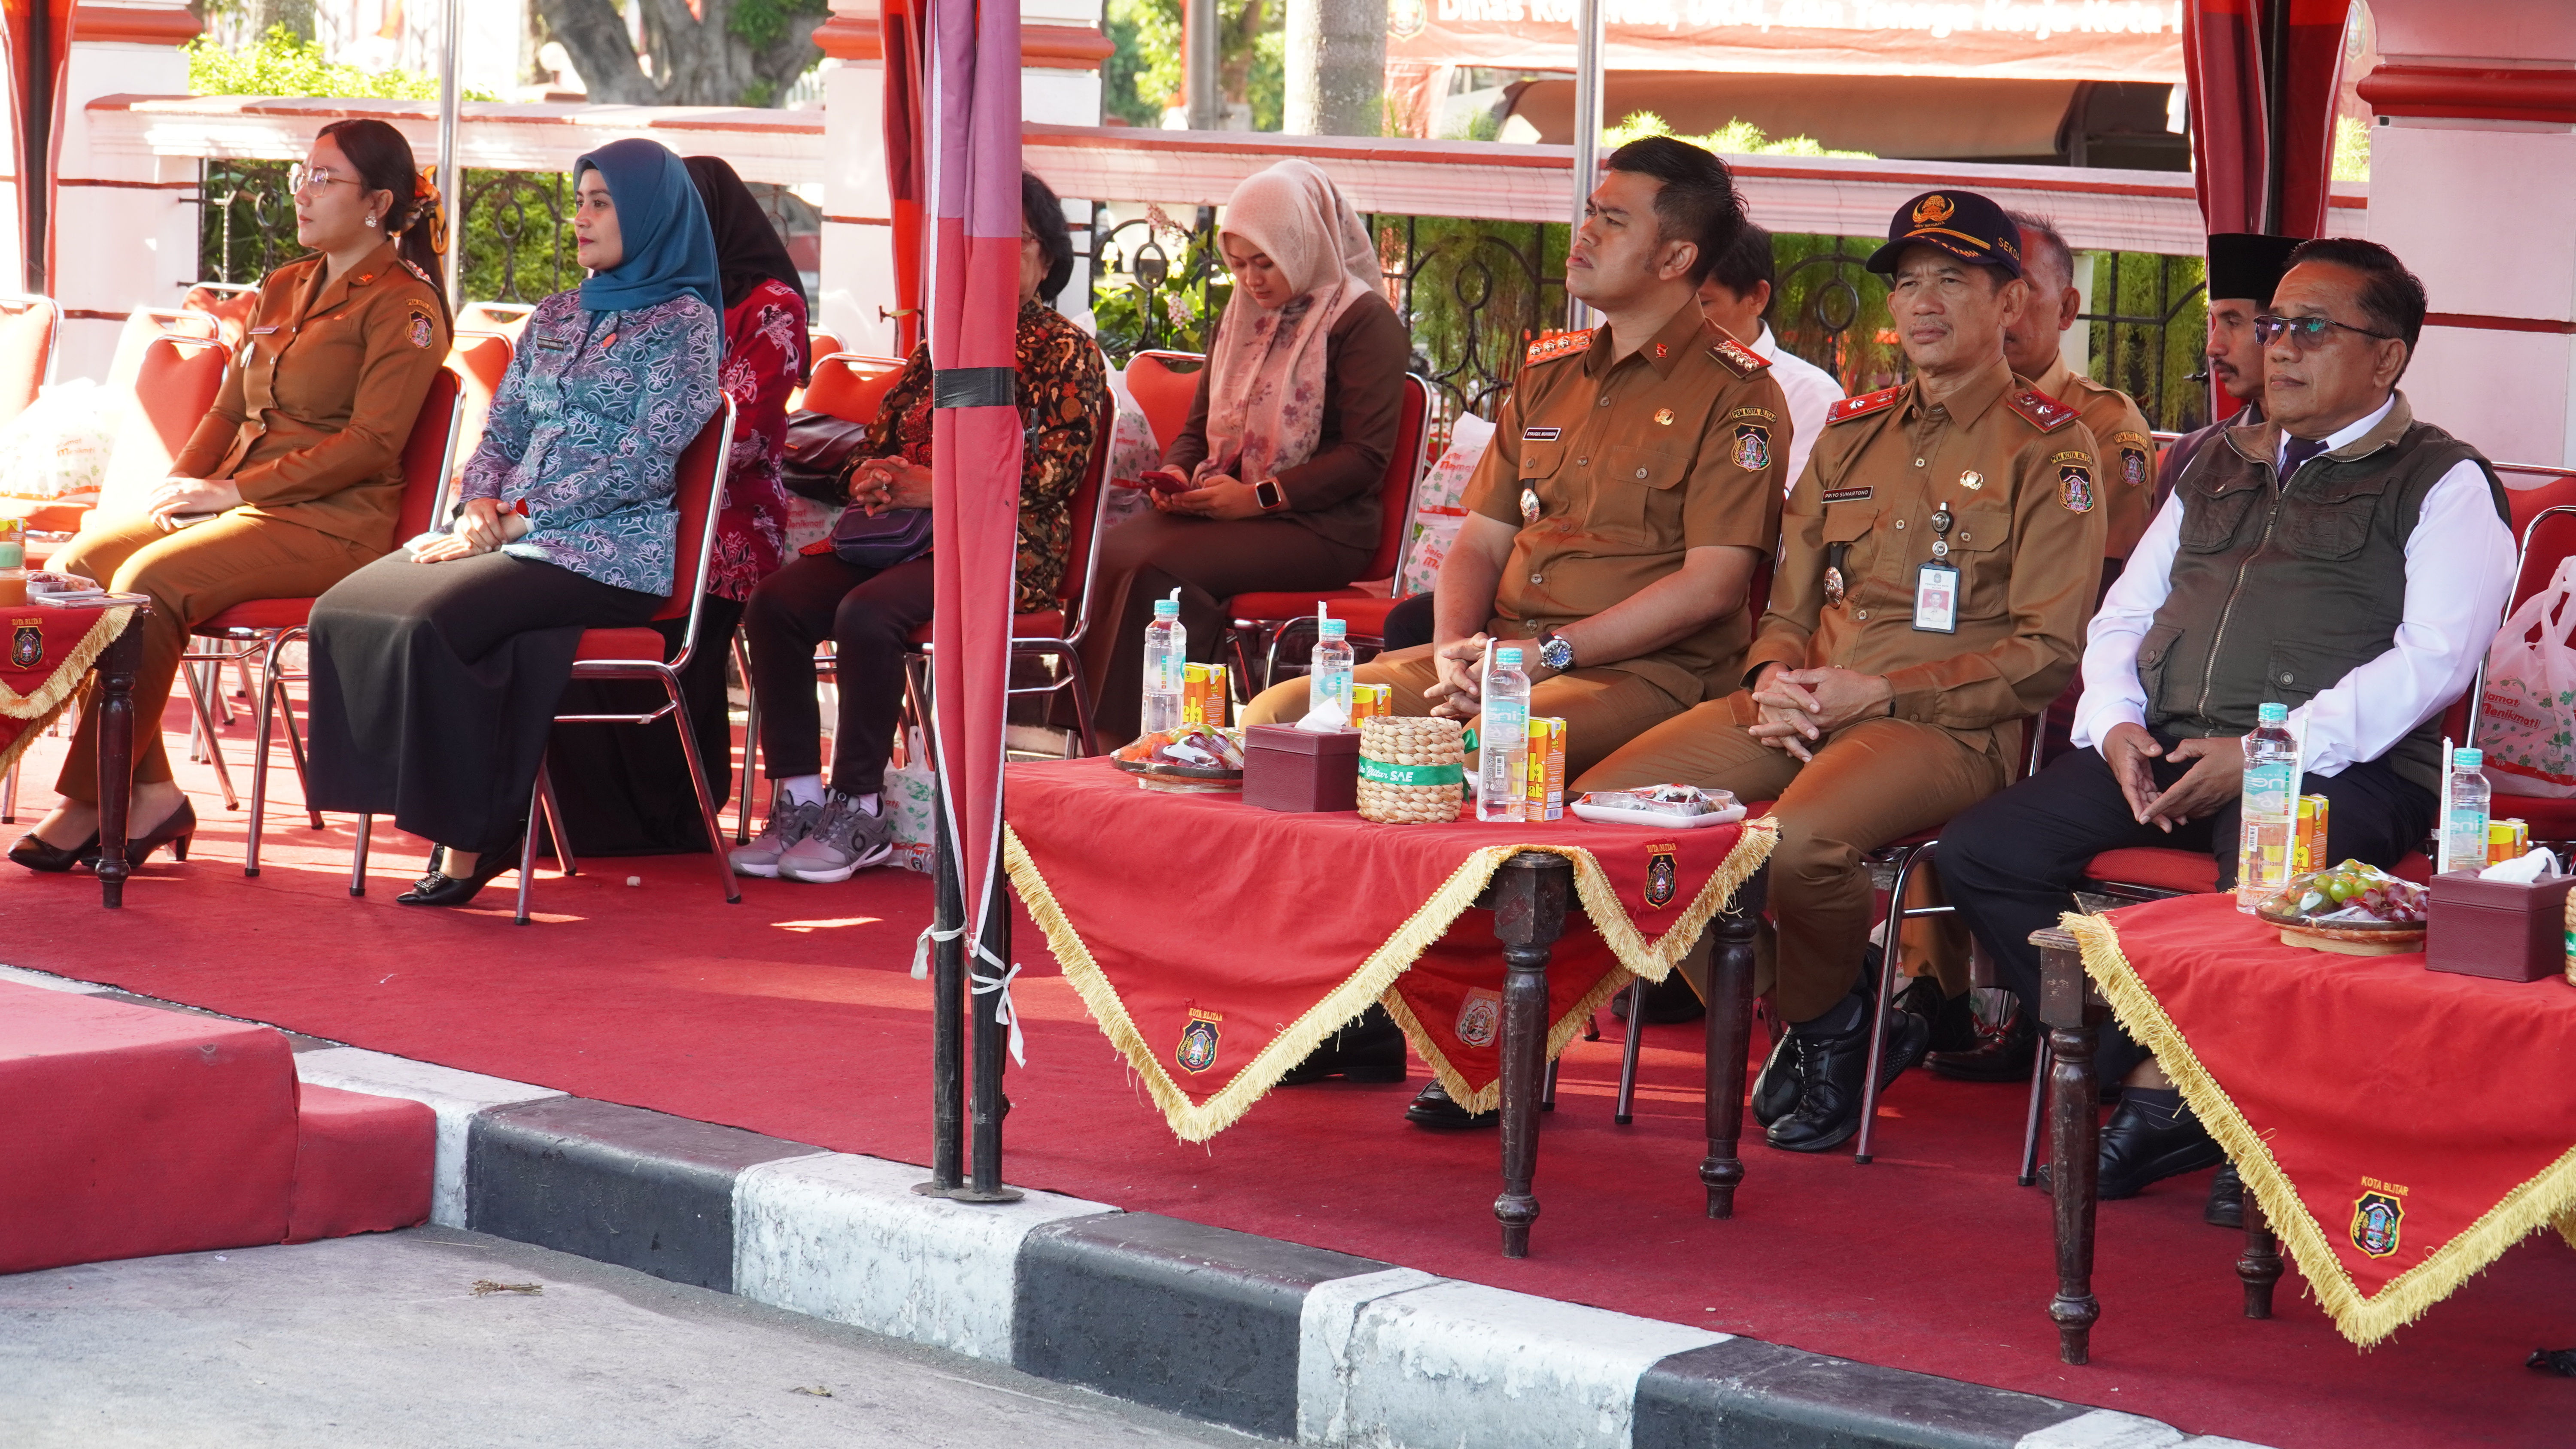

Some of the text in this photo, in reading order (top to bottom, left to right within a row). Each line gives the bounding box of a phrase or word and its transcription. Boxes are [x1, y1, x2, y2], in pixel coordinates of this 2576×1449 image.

[1438, 0, 1524, 21] Dinas
[1532, 0, 1678, 31] Koprasi,
[1851, 0, 1974, 38] Tenaga
[2081, 0, 2163, 33] Kota
[2063, 452, 2077, 460] KOTA
[1367, 765, 1388, 779] Blitar
[1188, 1007, 1202, 1018] KOTA
[2360, 1175, 2409, 1197] KOTA BLITAR
